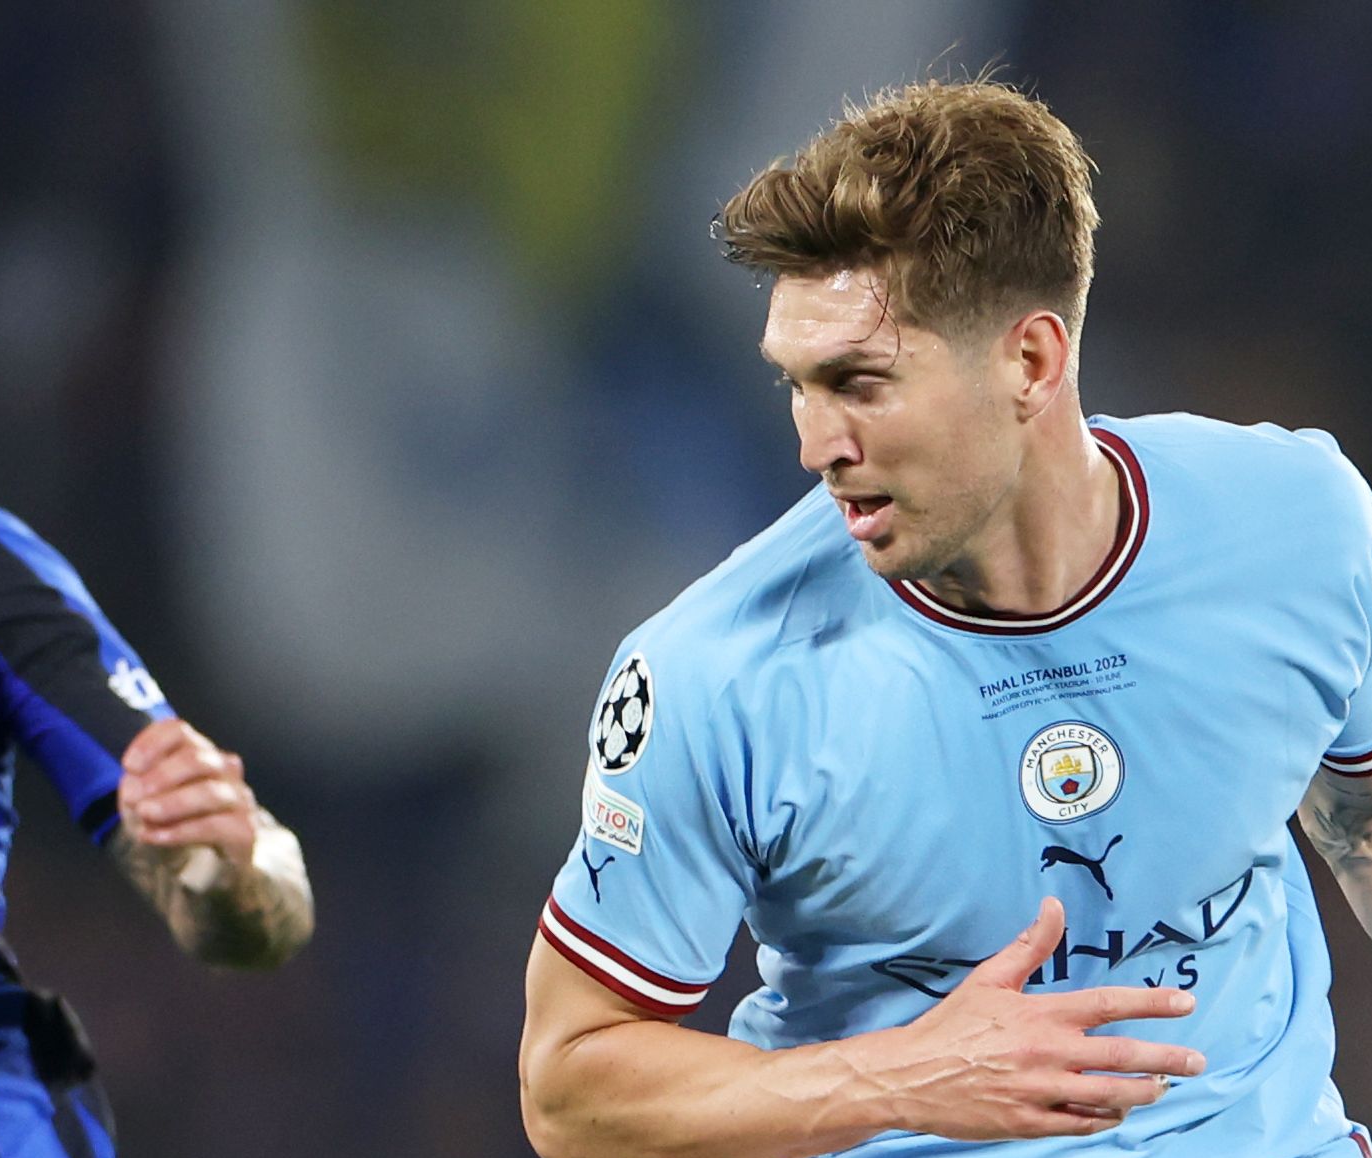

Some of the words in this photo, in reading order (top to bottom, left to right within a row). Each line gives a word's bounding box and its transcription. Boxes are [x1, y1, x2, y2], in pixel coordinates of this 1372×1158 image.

[979, 675, 1020, 699] FINAL
[1021, 662, 1092, 686] ISTANBUL
[1094, 653, 1128, 672] 2023
[1026, 728, 1109, 769] MANCHESTER
[1058, 802, 1089, 818] CITY
